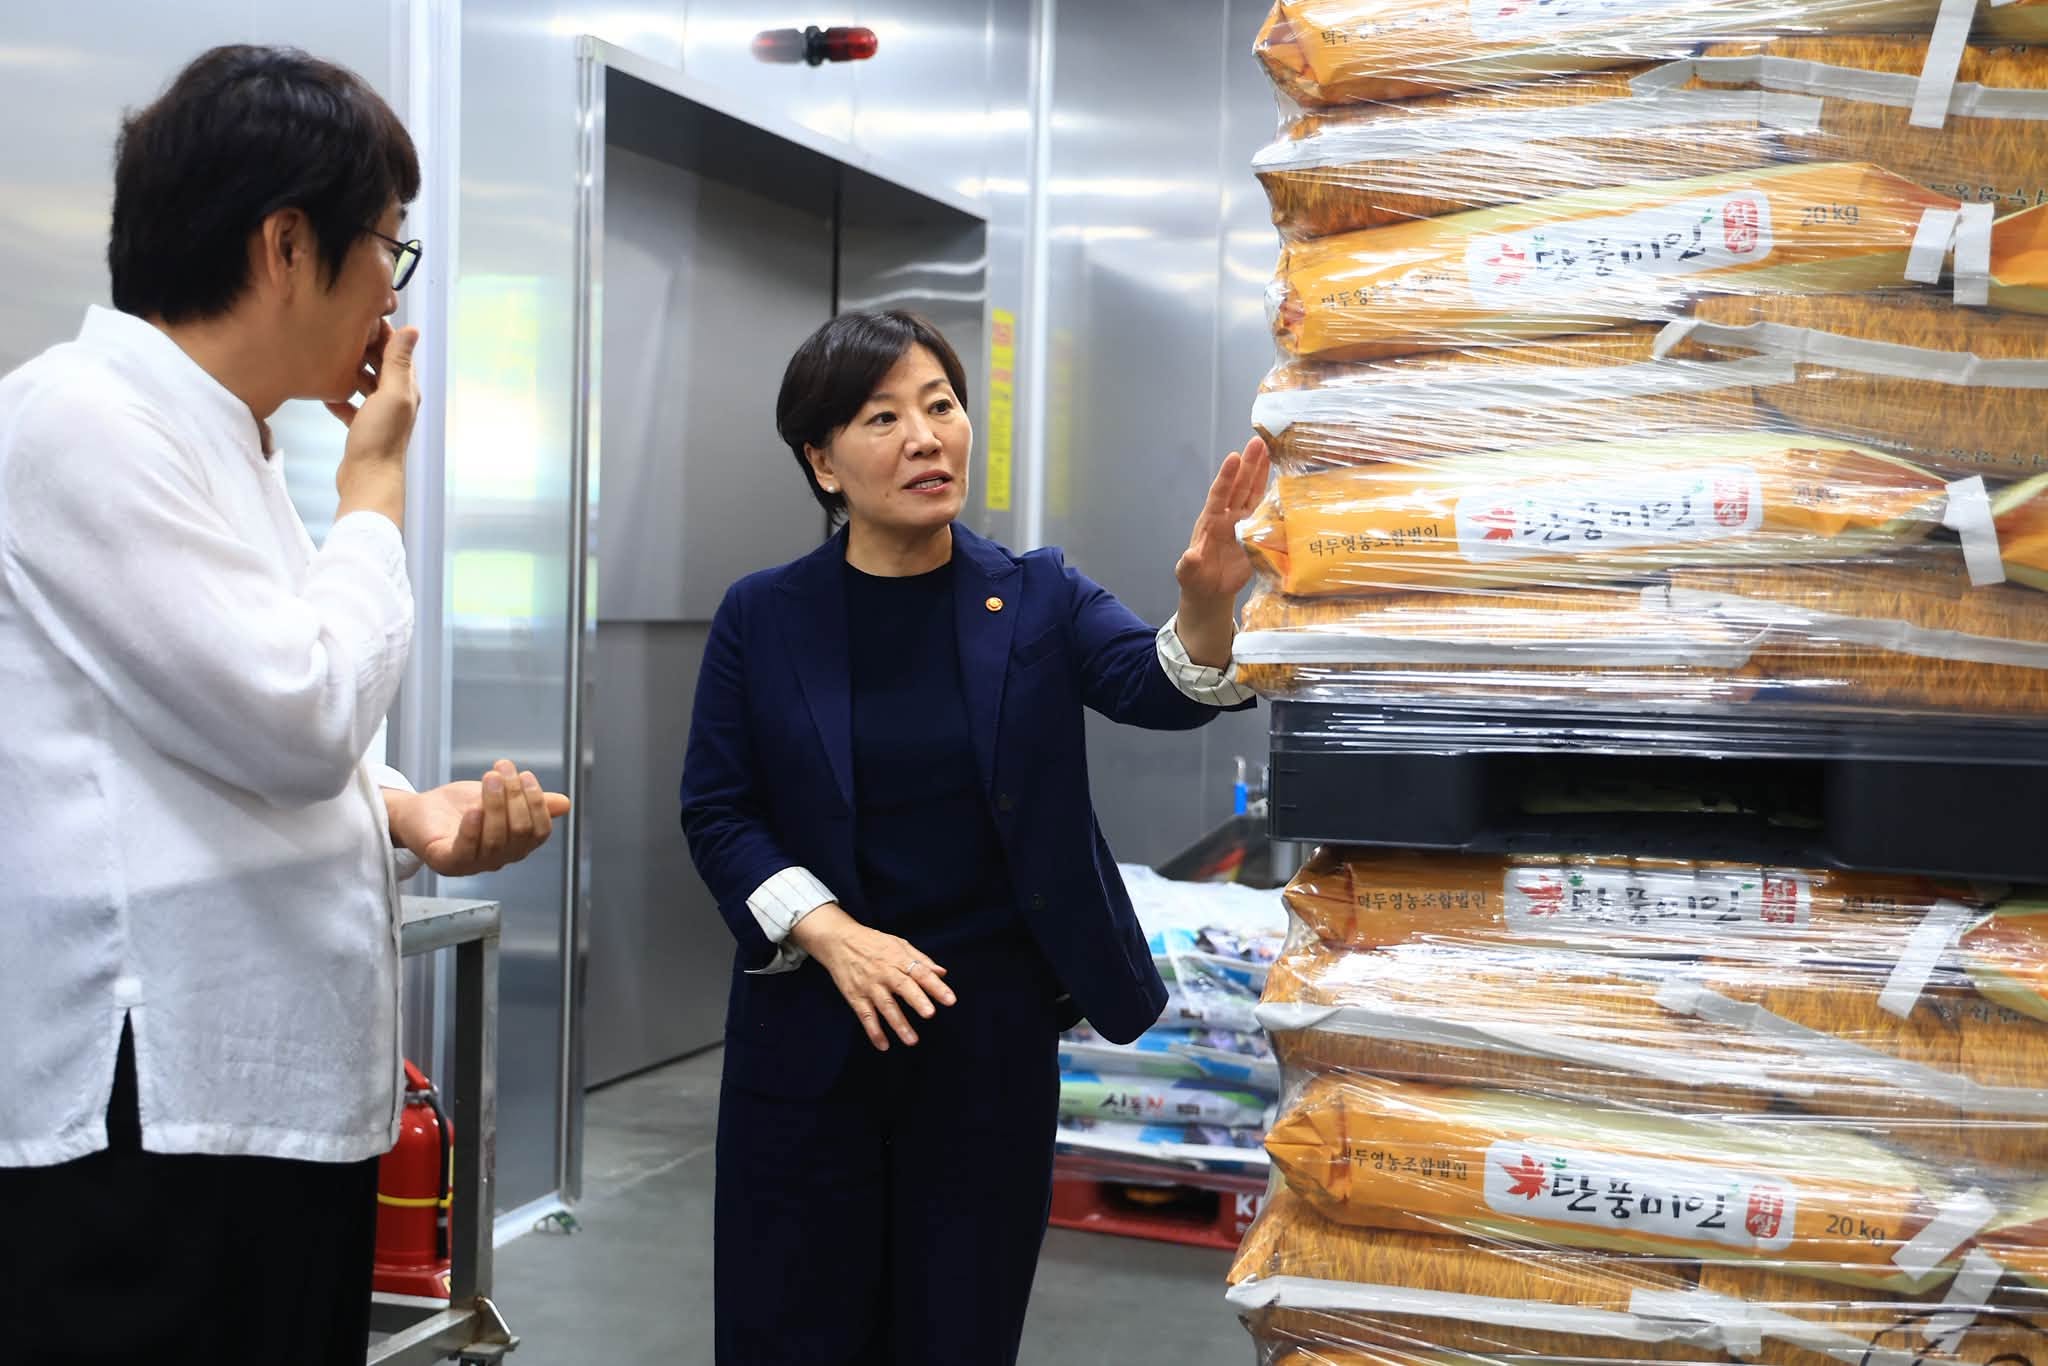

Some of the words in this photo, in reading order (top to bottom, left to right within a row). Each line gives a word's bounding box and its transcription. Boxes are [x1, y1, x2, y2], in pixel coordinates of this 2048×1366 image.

[1831, 202, 1860, 226] kg
[1825, 1214, 1854, 1237] 20
[1858, 1219, 1886, 1248] kg
